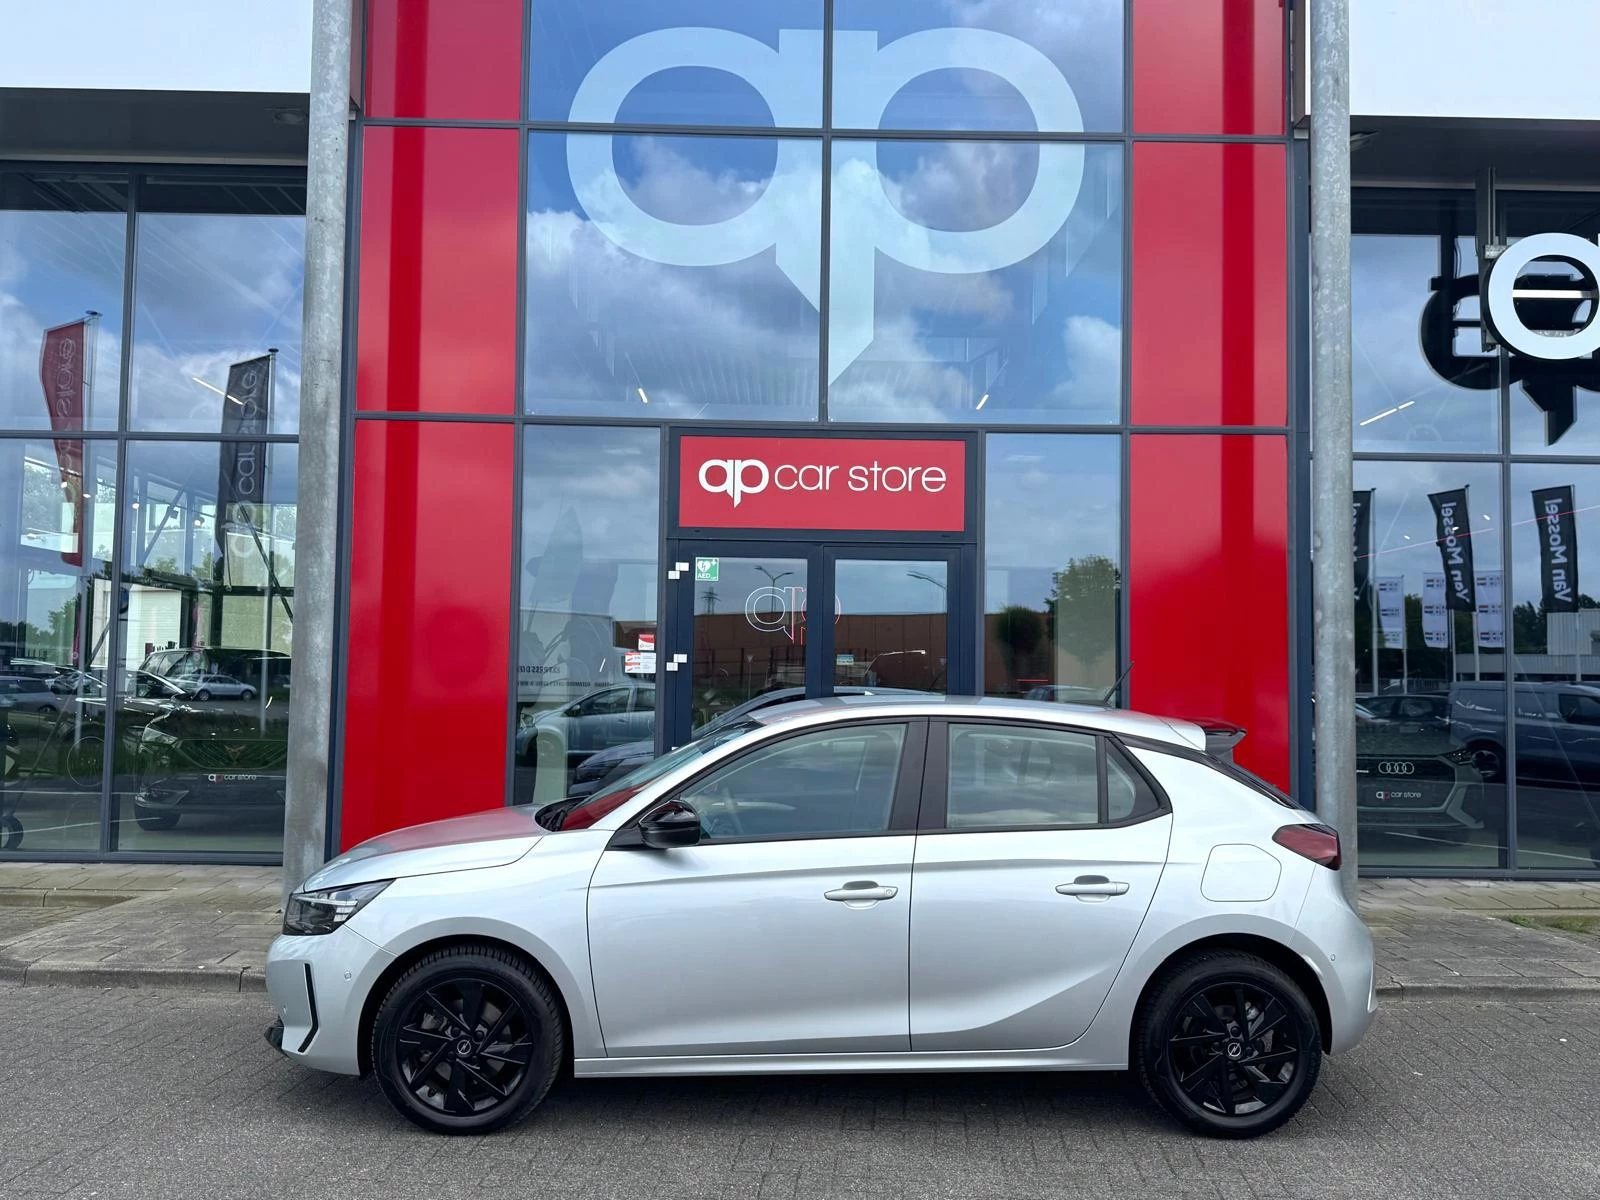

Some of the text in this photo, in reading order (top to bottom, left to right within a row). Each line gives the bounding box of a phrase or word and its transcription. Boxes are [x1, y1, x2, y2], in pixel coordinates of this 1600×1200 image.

[698, 458, 947, 508] ap car store
